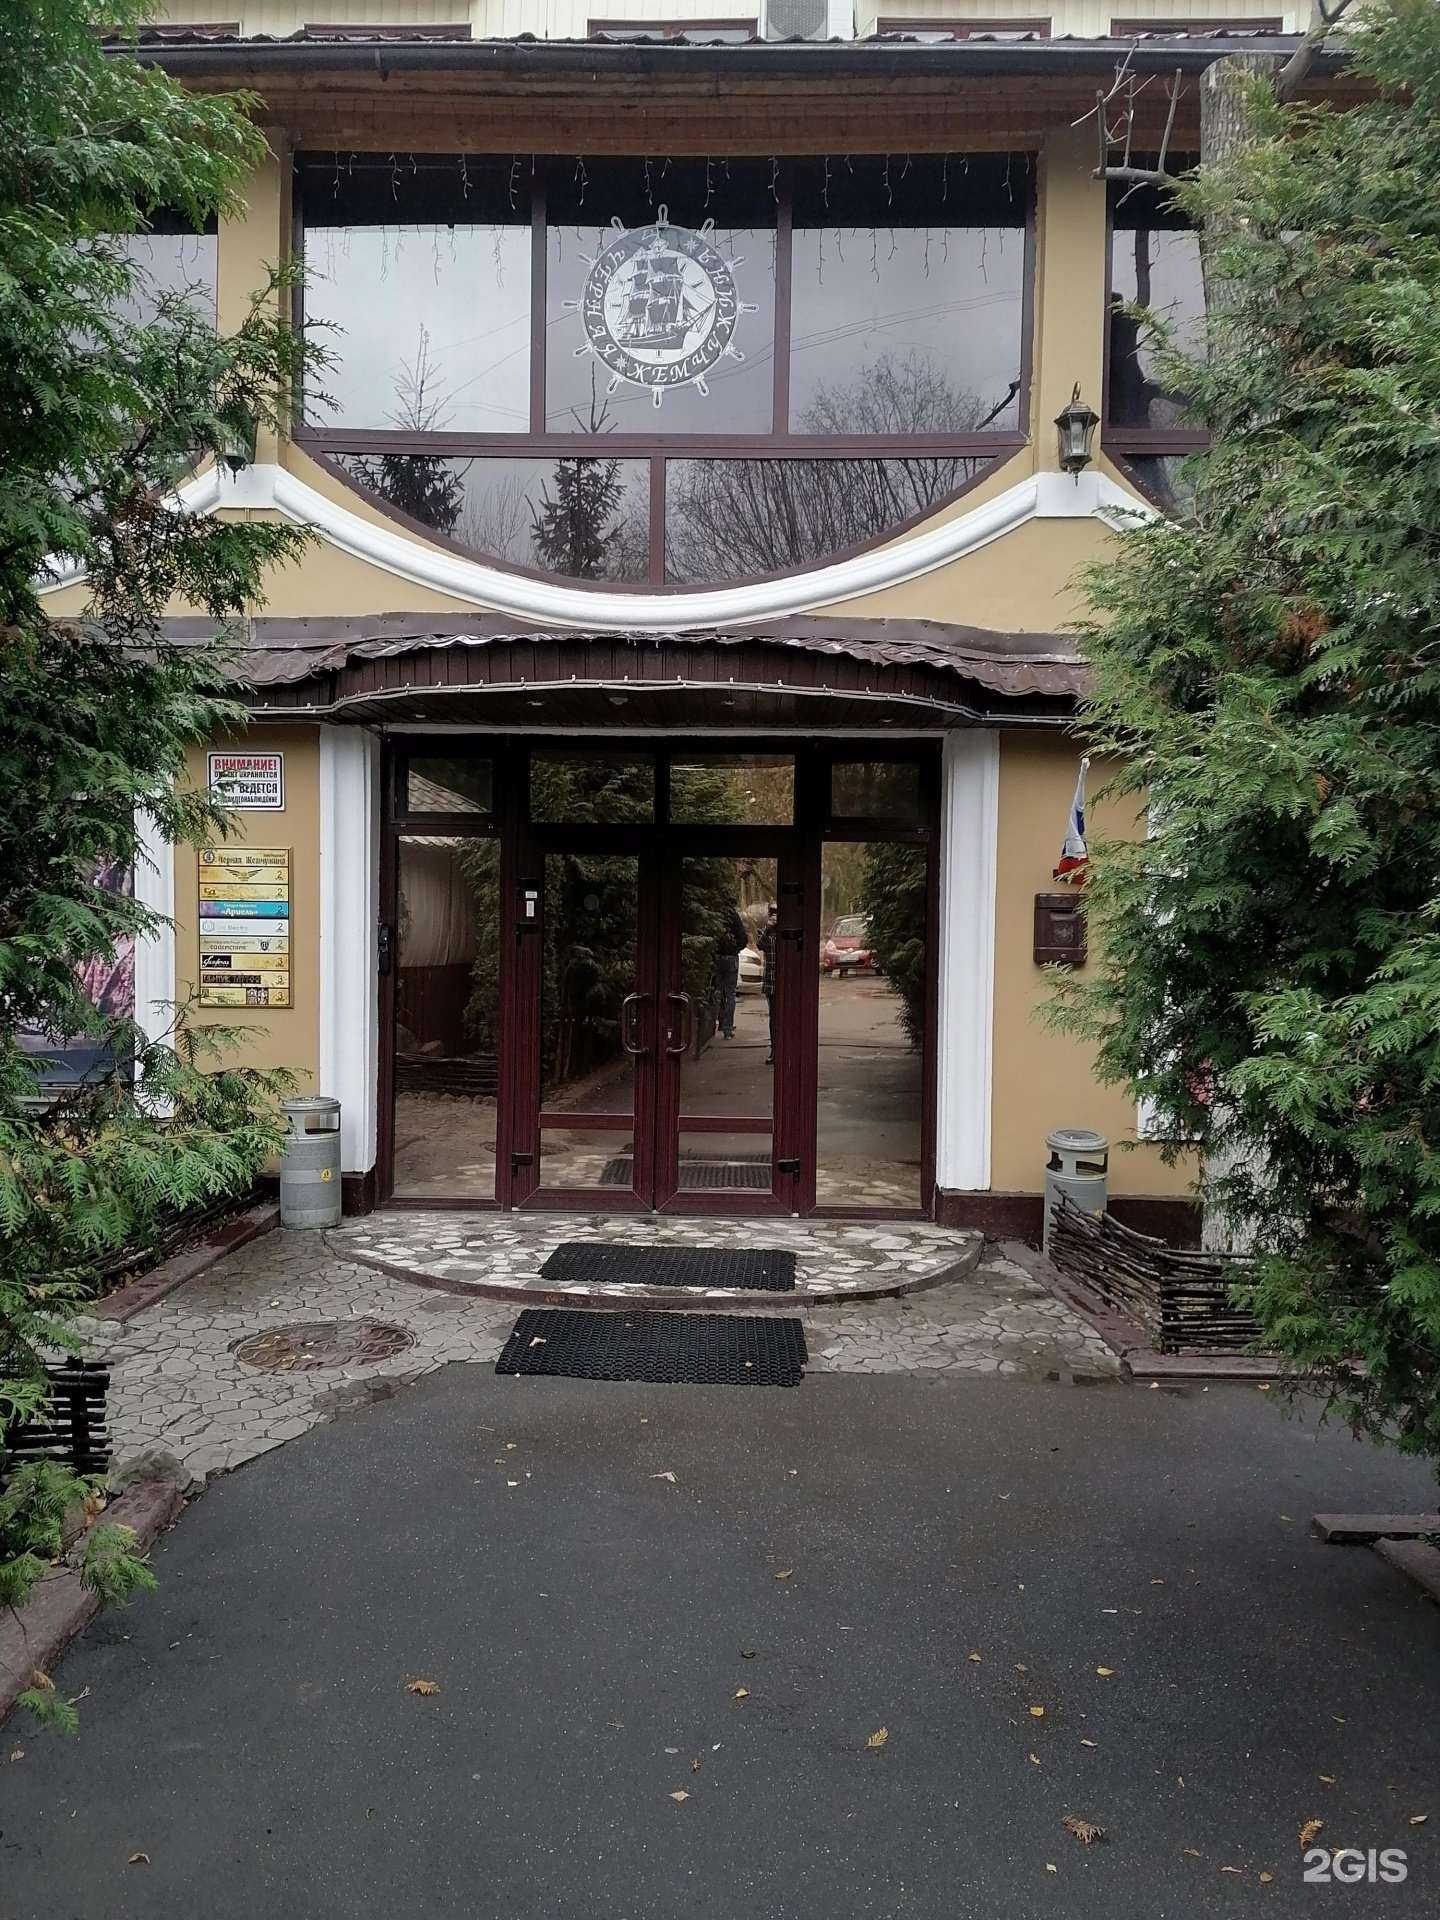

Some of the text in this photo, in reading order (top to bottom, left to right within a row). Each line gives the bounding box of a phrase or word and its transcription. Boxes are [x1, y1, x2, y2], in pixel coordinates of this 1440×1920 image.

[627, 247, 736, 384] ЖЕМЧУЖИНА
[214, 758, 277, 770] ВНИМАНИЕ!
[239, 782, 278, 795] ВЕДЕТСЯ
